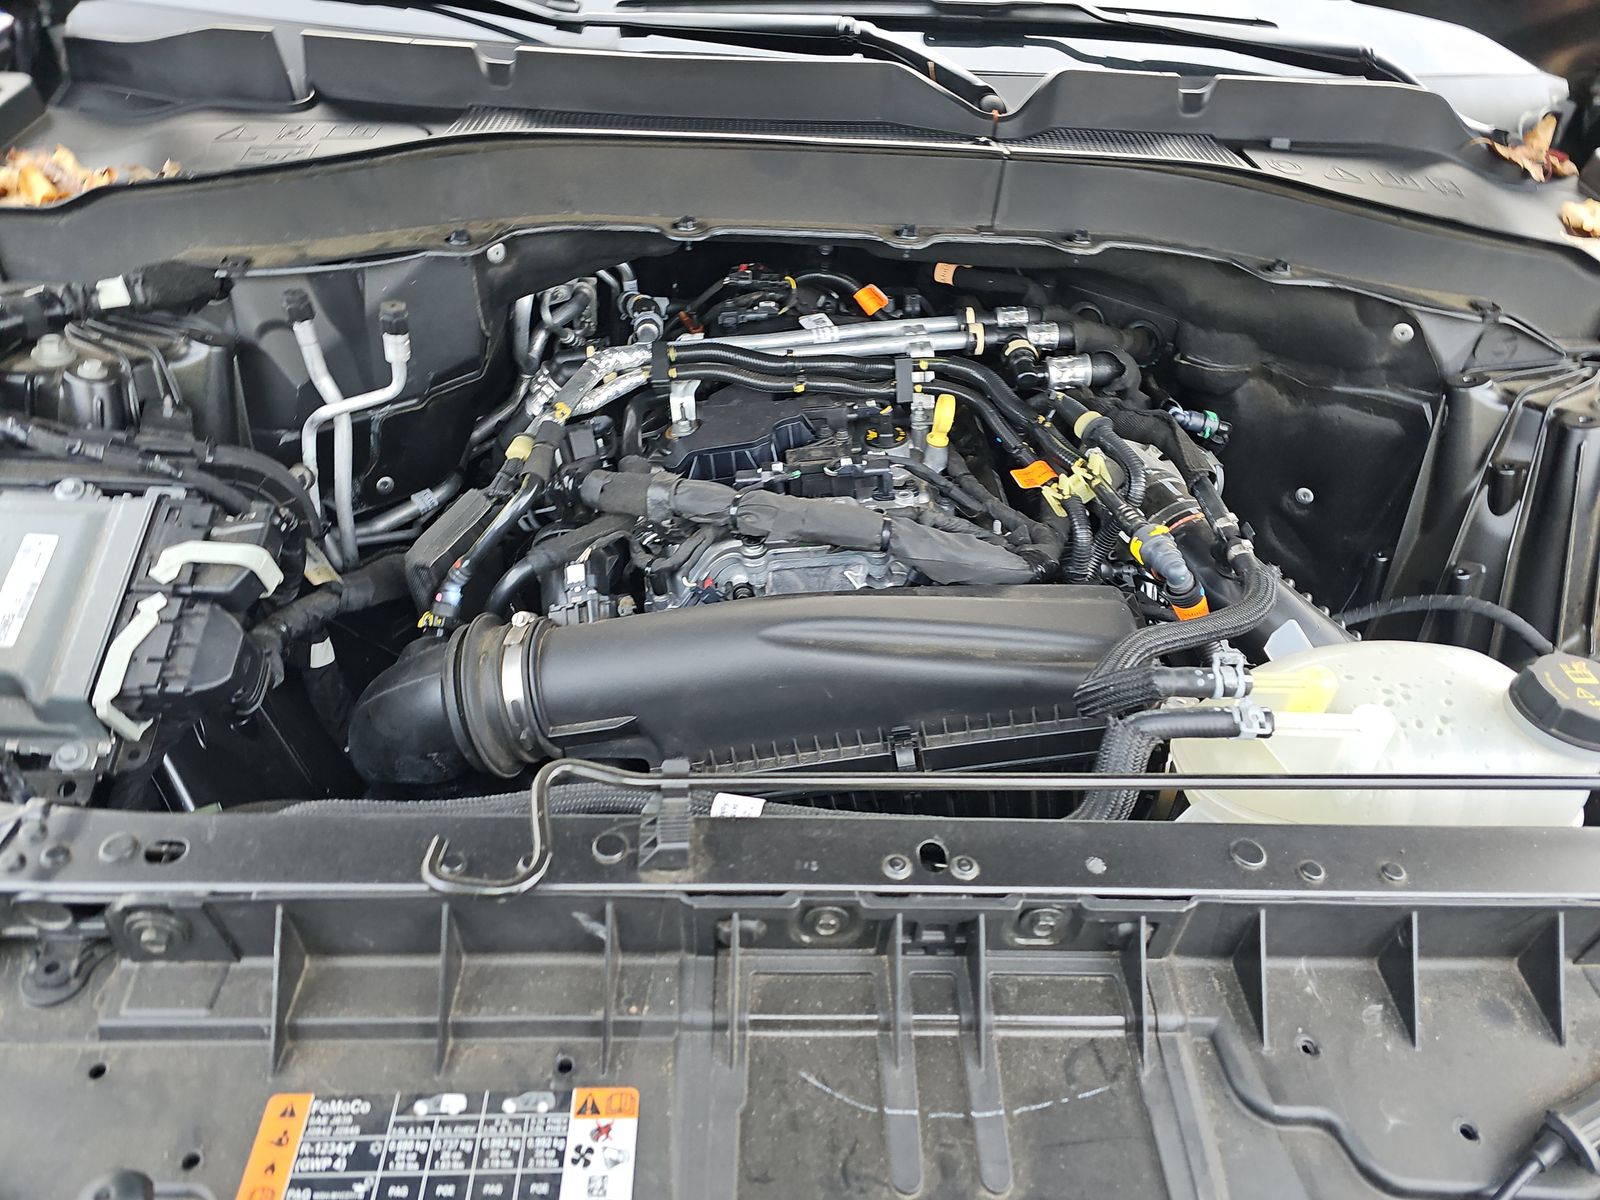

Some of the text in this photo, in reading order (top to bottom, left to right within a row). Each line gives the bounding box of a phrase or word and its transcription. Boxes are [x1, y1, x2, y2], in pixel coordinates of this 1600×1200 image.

[311, 1098, 372, 1115] FoMoCo
[299, 1141, 357, 1157] R-1234yf
[294, 1157, 332, 1173] (GWP
[286, 1187, 312, 1200] PAG
